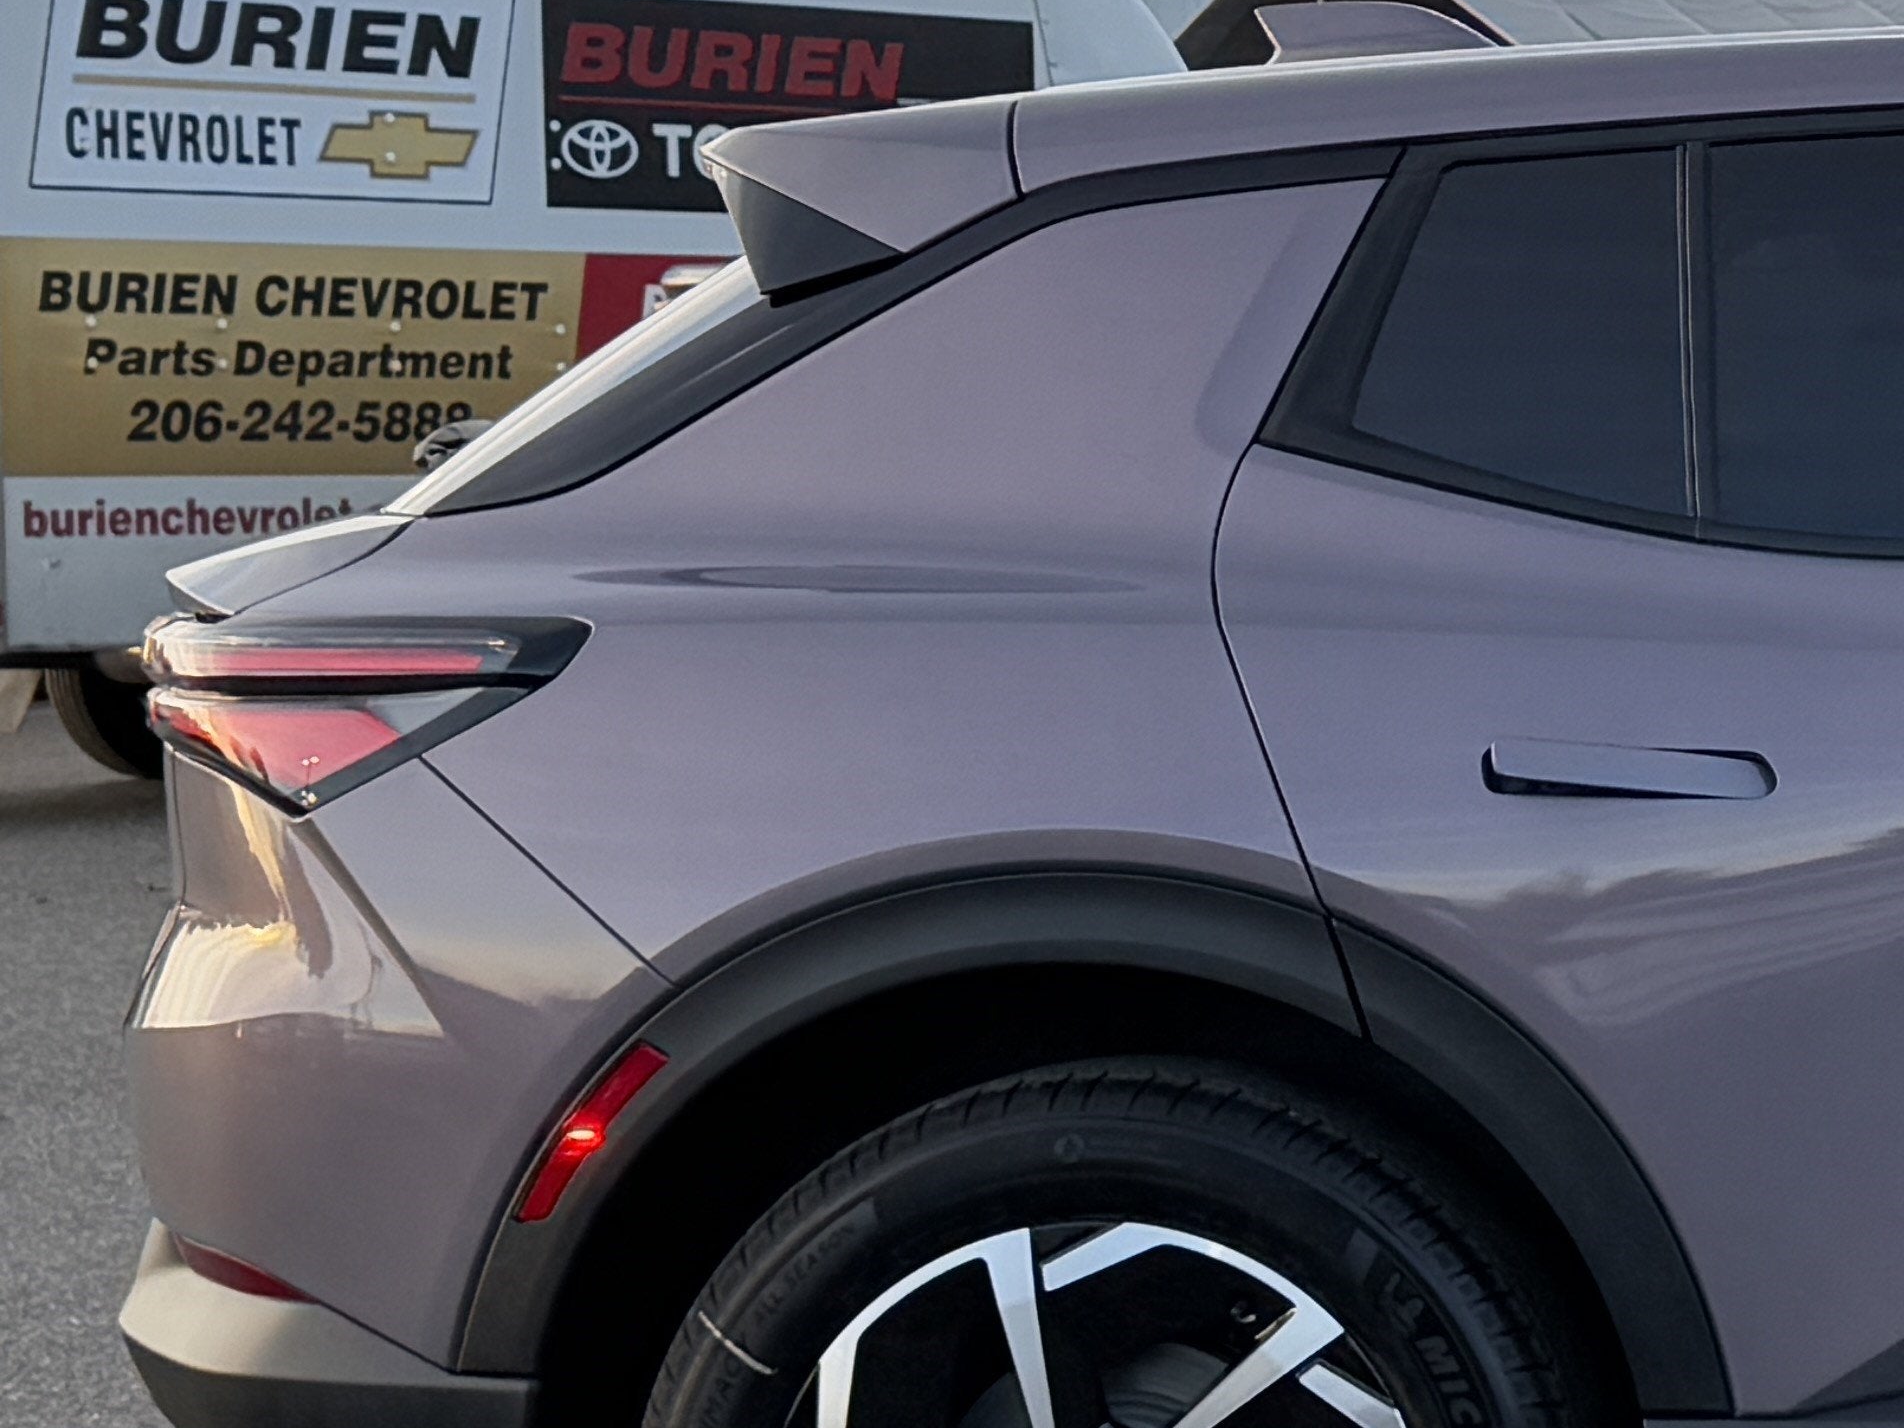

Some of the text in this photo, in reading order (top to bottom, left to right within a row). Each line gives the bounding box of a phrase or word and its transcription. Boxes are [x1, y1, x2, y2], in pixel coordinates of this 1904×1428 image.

[560, 21, 904, 101] BURIEN
[65, 107, 301, 167] CHEVROLET
[39, 270, 549, 321] BURIEN CHEVROLET
[84, 338, 514, 387] Parts Department
